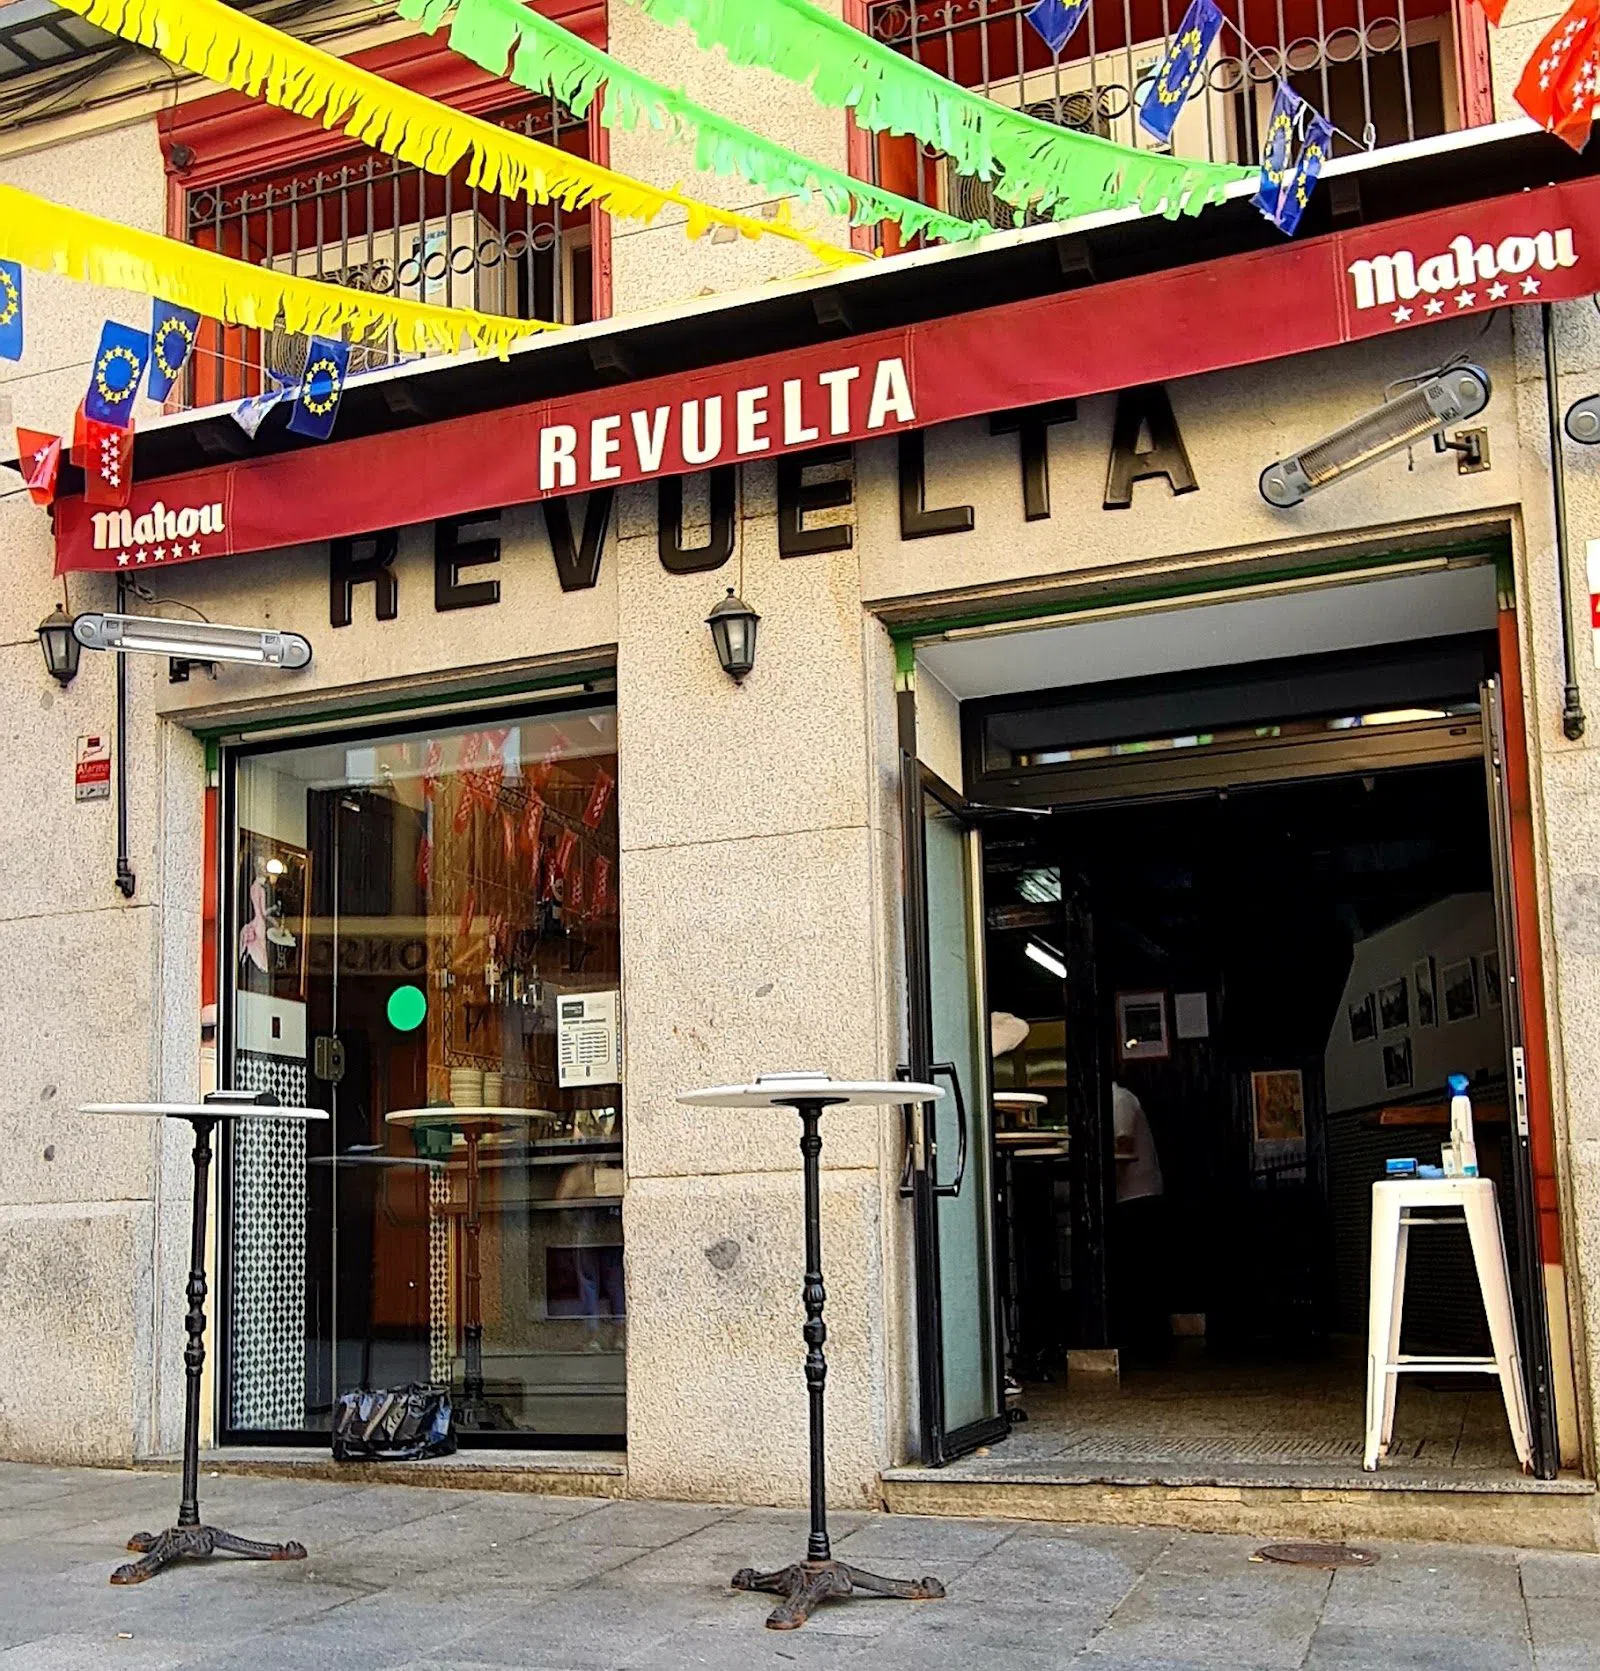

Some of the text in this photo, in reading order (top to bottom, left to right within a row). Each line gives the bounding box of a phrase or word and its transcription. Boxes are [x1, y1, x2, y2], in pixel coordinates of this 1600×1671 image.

[1347, 227, 1579, 310] Mahou
[539, 357, 917, 491] REVUELTA
[90, 501, 226, 549] Mahou
[329, 385, 1200, 628] REVUELTA
